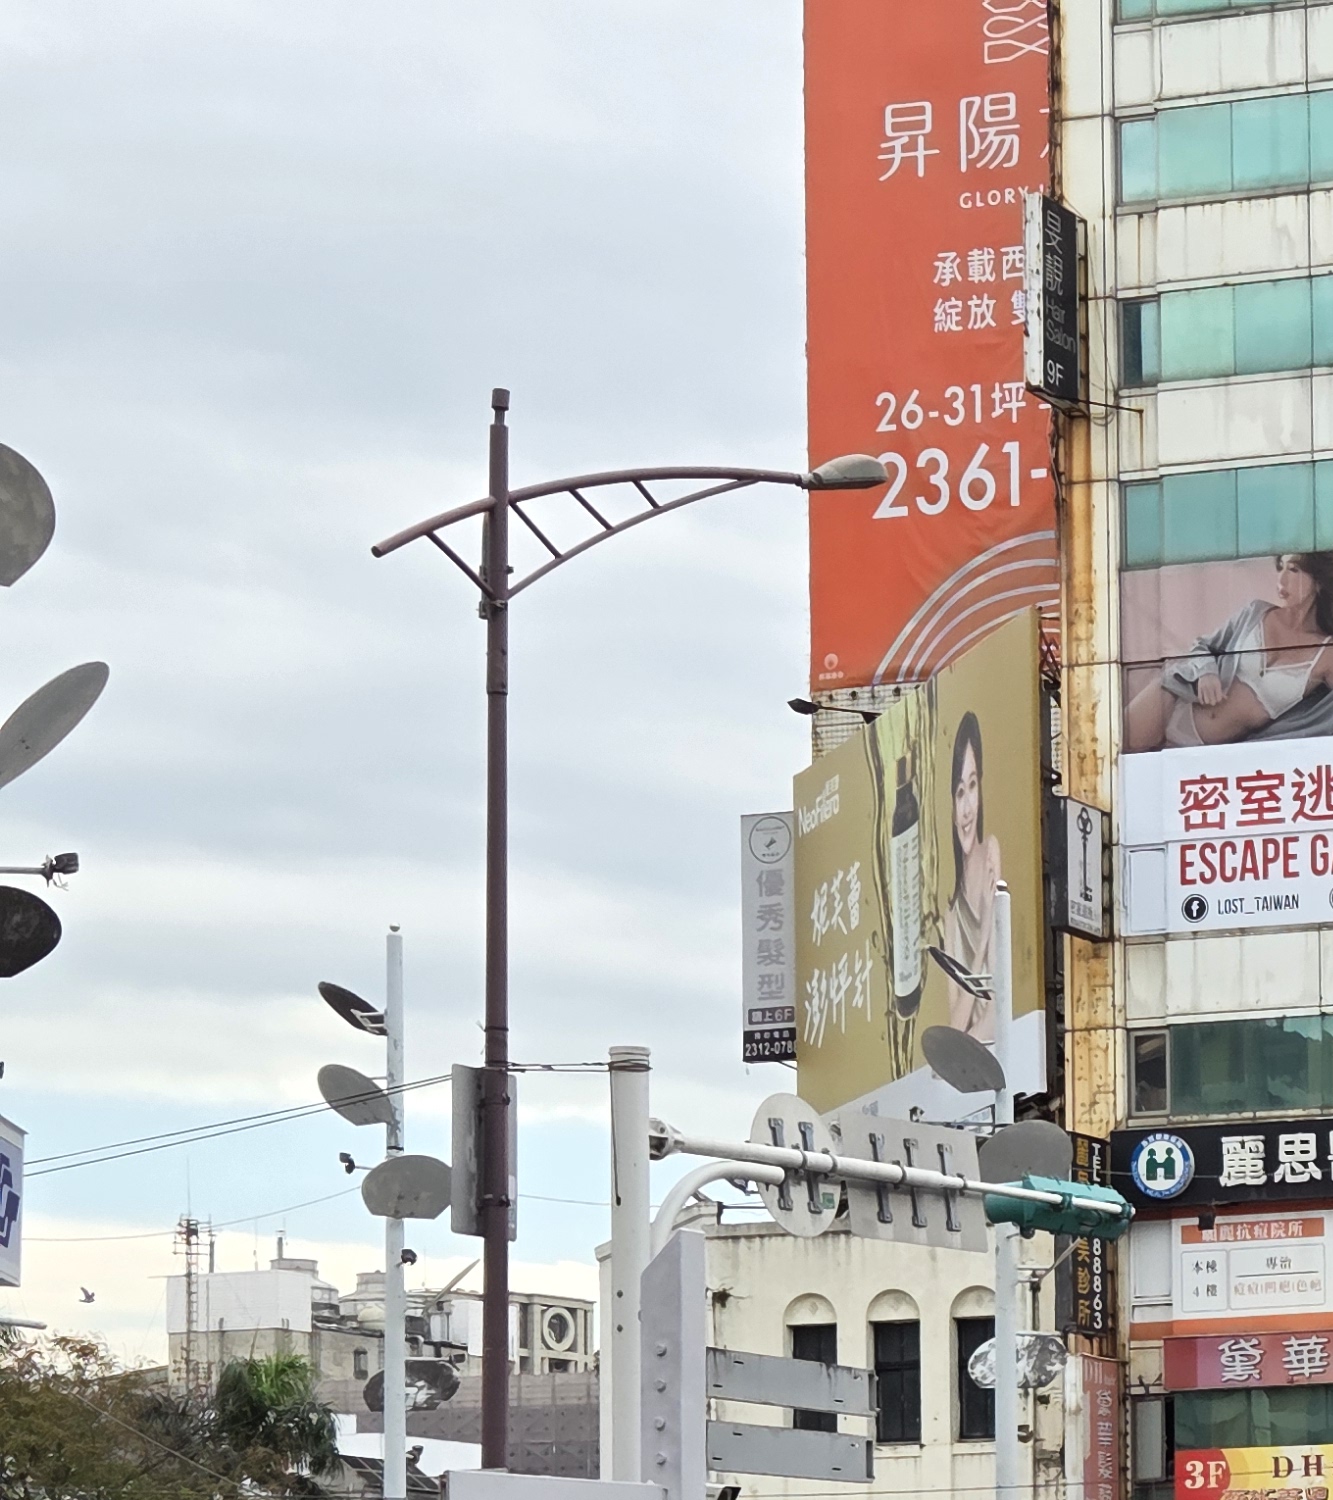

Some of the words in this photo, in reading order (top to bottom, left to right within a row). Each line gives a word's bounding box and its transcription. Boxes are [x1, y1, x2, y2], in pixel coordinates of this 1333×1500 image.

[933, 246, 1025, 287] 承載西
[933, 298, 997, 334] 綻放
[1046, 319, 1077, 354] Salon
[1047, 359, 1065, 387] 9F
[875, 382, 1027, 433] 26-31坪
[1180, 835, 1300, 886] ESCAPE
[1217, 892, 1300, 917] LOST_TAIWAN
[755, 868, 786, 1001] 優秀髮型
[1185, 1459, 1227, 1490] 3F
